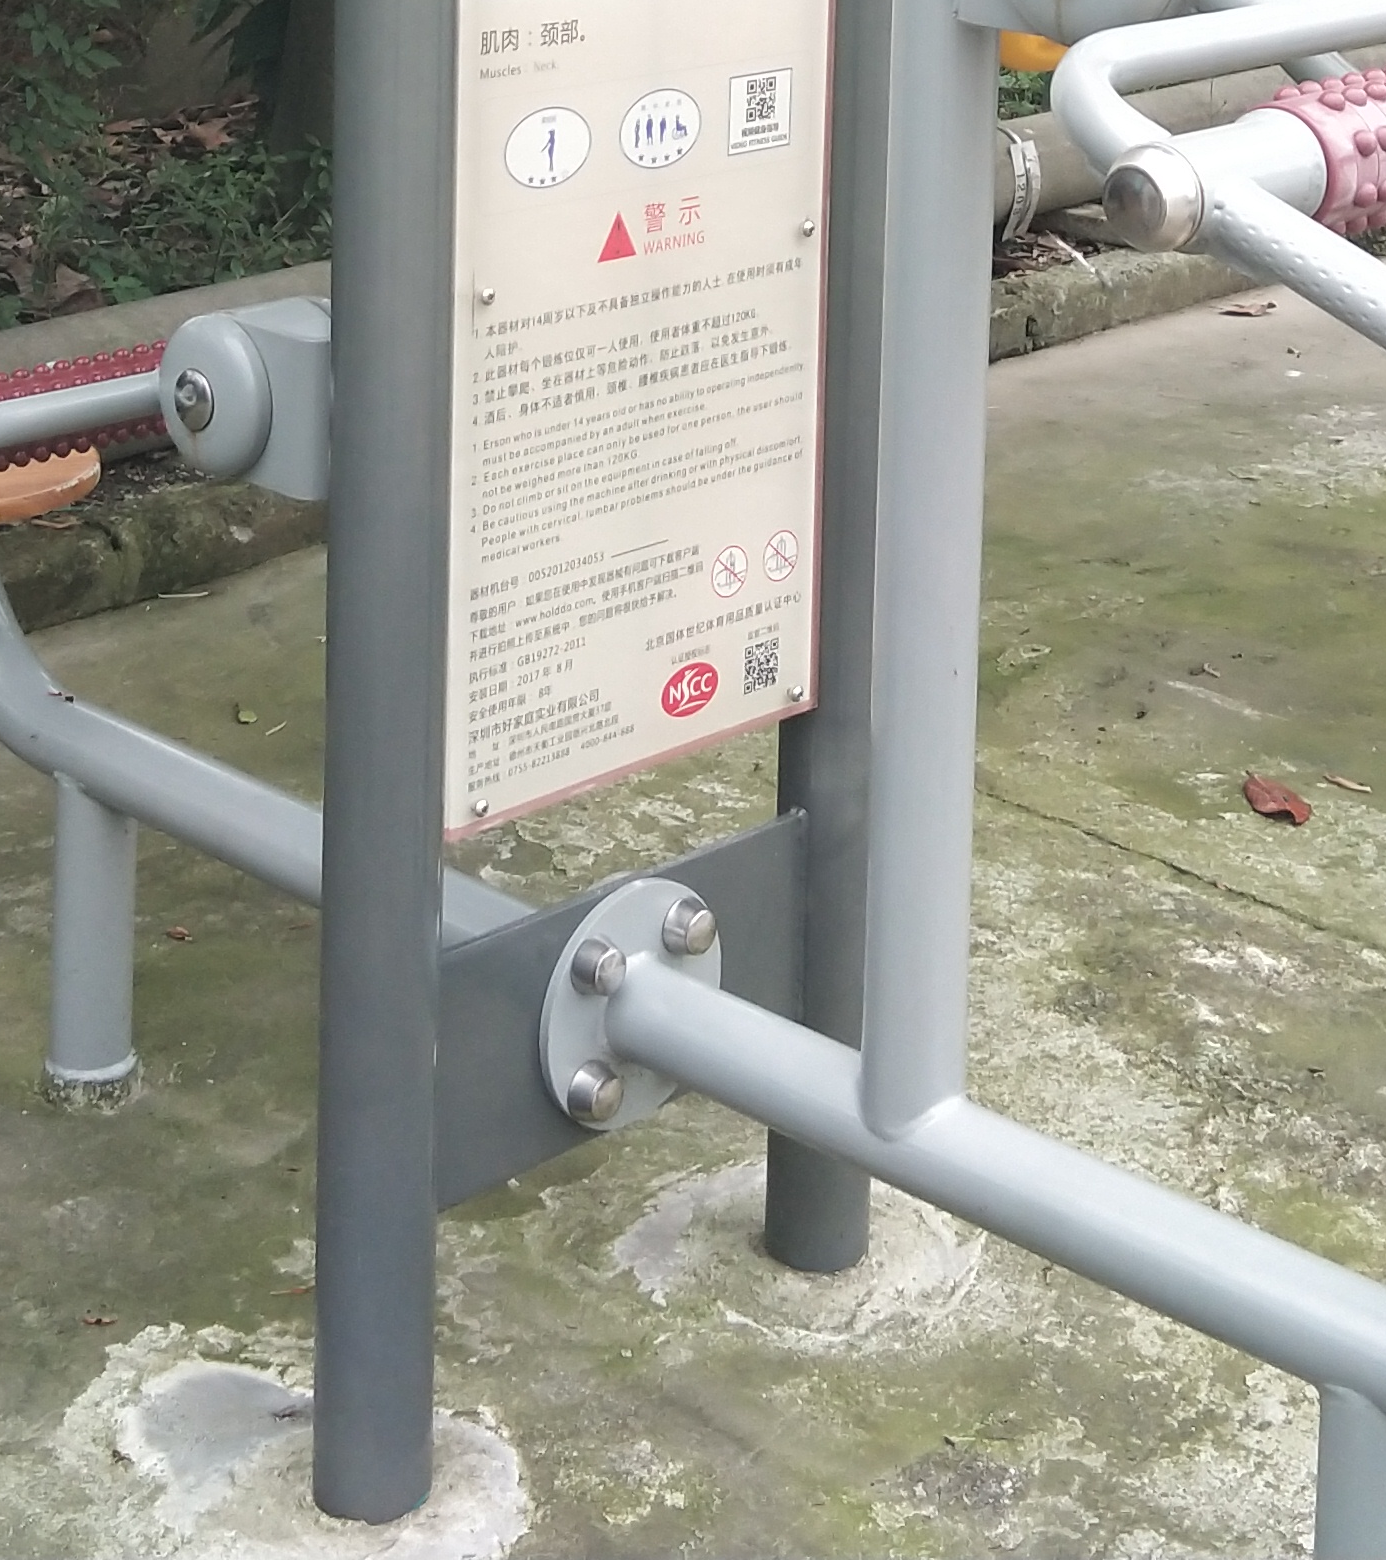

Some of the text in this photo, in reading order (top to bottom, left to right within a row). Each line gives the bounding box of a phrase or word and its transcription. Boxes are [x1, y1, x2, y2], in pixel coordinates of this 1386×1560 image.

[480, 19, 586, 56] 肌肉：颈部。
[643, 195, 702, 234] 警示
[643, 230, 705, 256] WARNING
[513, 430, 532, 441] who
[535, 429, 542, 437] is
[545, 422, 570, 435] under
[574, 417, 583, 427] 14
[586, 410, 610, 425] years
[628, 404, 638, 413] or
[639, 398, 655, 410] has
[657, 396, 666, 406] no
[669, 388, 694, 402] ability
[696, 384, 705, 395] to
[707, 376, 745, 394] operating
[483, 452, 506, 466] must
[509, 449, 521, 460] be
[523, 432, 587, 456] accompanied
[590, 430, 600, 440] by
[603, 426, 613, 435] an
[641, 412, 665, 425] when
[484, 468, 509, 483] Each
[512, 457, 555, 475] exercise
[558, 449, 584, 464] place
[586, 444, 604, 455] can
[629, 434, 640, 445] be
[643, 428, 665, 441] used
[667, 423, 680, 434] for
[682, 419, 699, 431] one
[737, 406, 751, 416] the
[753, 400, 772, 412] user
[774, 392, 803, 406] should
[481, 530, 516, 547] People
[519, 524, 539, 536] with
[586, 502, 618, 518] lumbar
[666, 481, 696, 496] should
[698, 476, 708, 487] be
[711, 469, 736, 483] under
[738, 465, 751, 475] the
[753, 454, 793, 471] guidance
[795, 449, 803, 459] of
[482, 486, 498, 499] not
[500, 483, 512, 494] be
[514, 472, 555, 490] weighed
[557, 465, 581, 479] more
[584, 460, 604, 472] than
[483, 504, 496, 516] Do
[499, 498, 514, 510] not
[517, 491, 543, 506] climb
[545, 489, 555, 499] or
[571, 481, 582, 491] on
[585, 475, 599, 486] the
[602, 462, 650, 484] equipment
[652, 460, 660, 469] in
[662, 455, 683, 466] case
[685, 450, 694, 460] of
[483, 519, 495, 531] Be
[498, 508, 539, 527] cautious
[541, 500, 567, 515] using
[569, 496, 584, 507] the
[587, 486, 626, 502] machine
[651, 467, 687, 485] drinking
[689, 464, 697, 474] or
[700, 458, 718, 471] with
[720, 450, 755, 467] physical
[481, 545, 519, 563] medical
[468, 688, 599, 745] 深圳市好家庭实业有限公司
